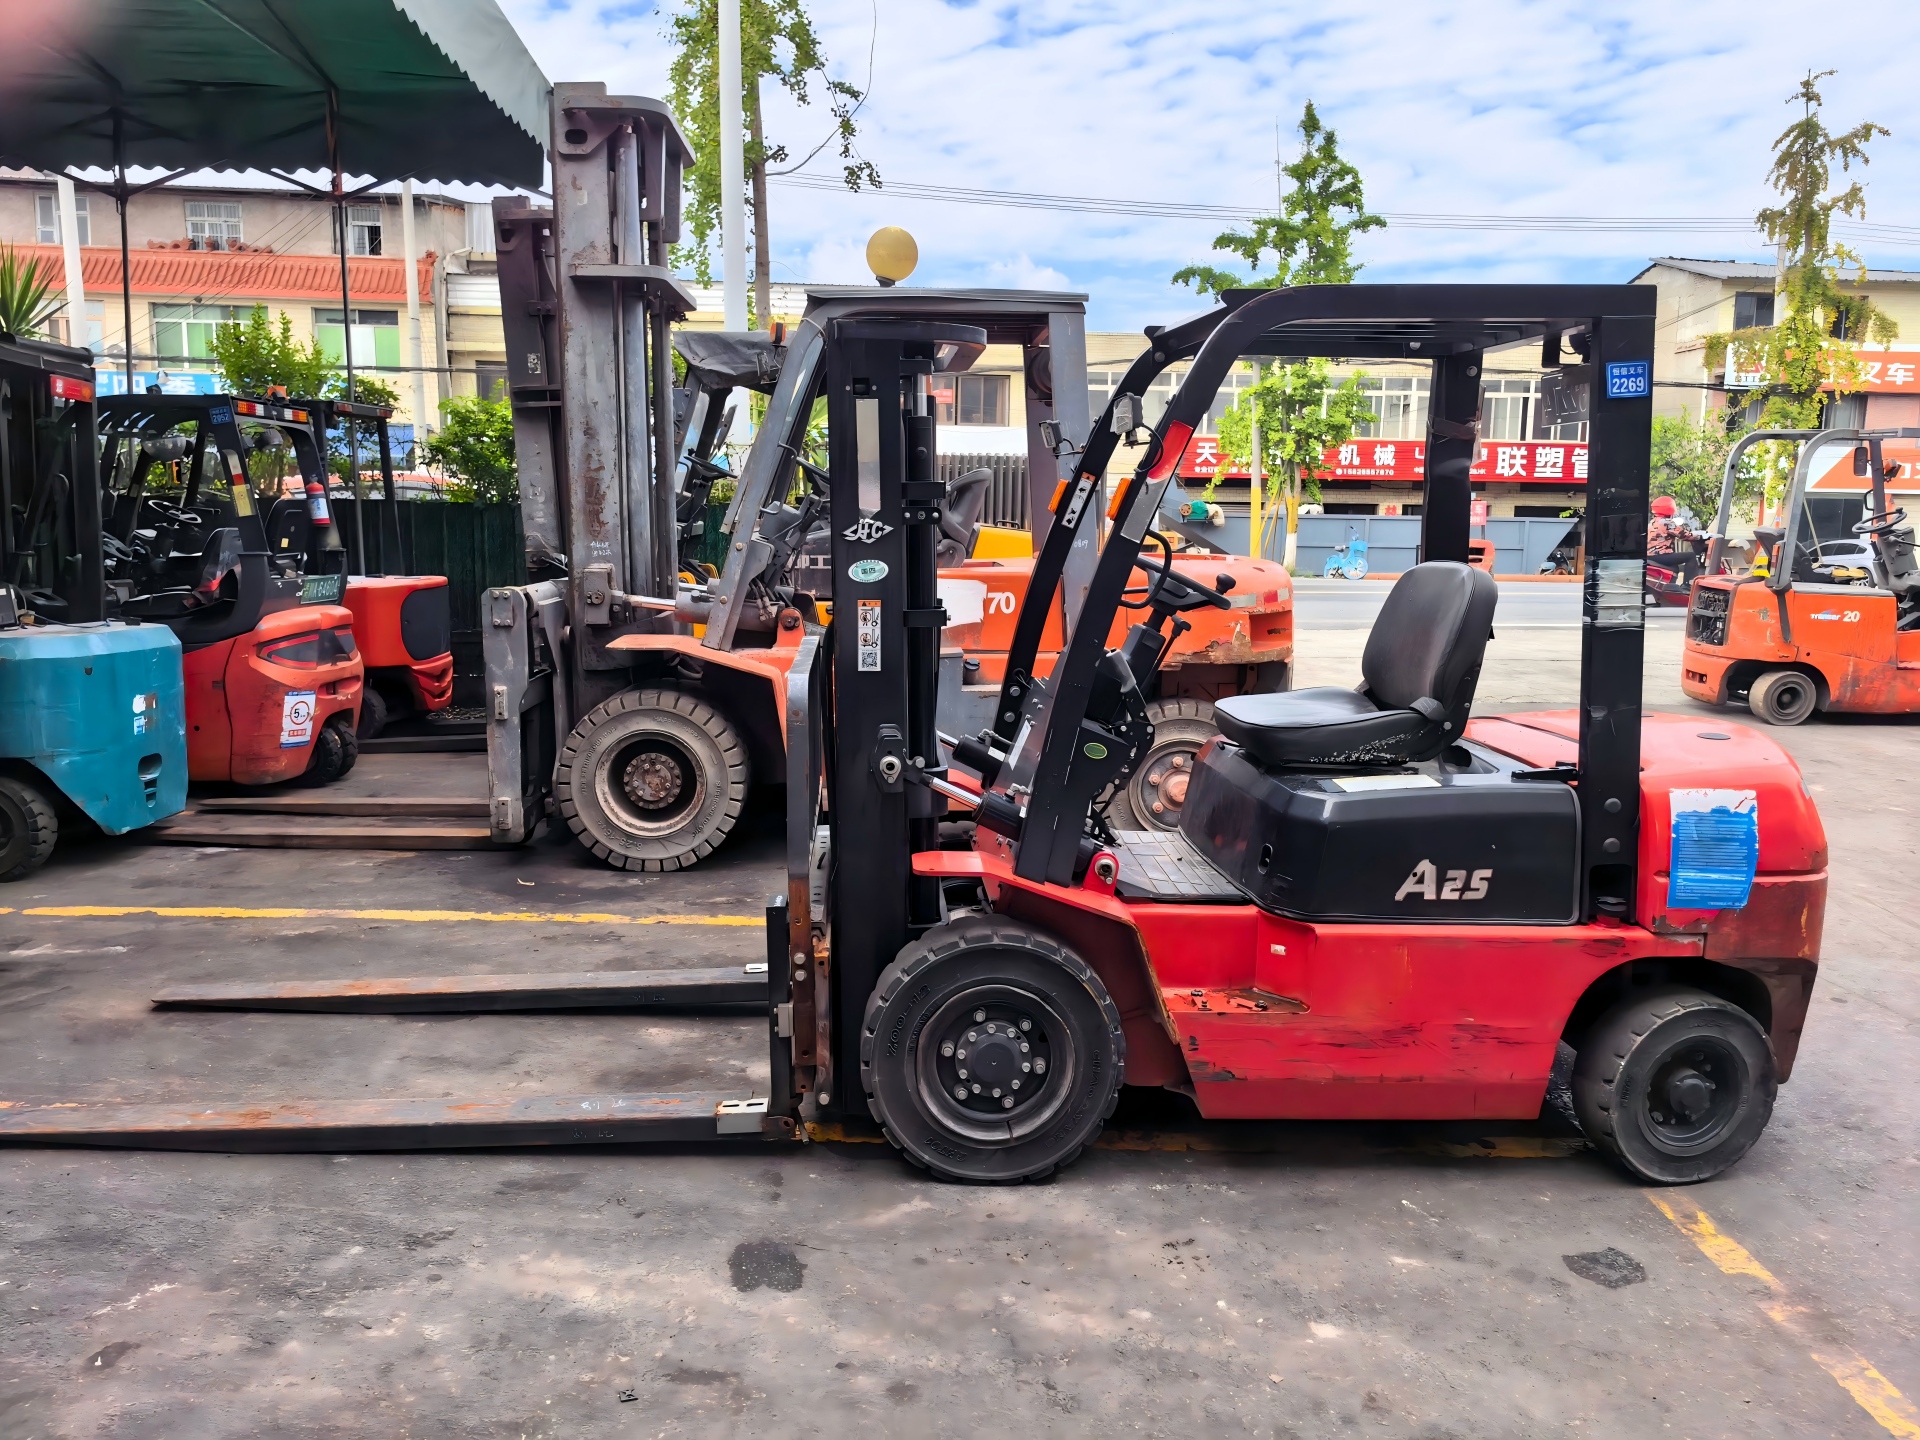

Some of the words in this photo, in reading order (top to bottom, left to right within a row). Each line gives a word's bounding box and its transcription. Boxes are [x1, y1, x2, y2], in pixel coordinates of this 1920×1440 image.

[1612, 366, 1644, 376] 恒信叉车
[1612, 376, 1645, 393] 2269
[987, 591, 1016, 614] 70
[1842, 610, 1861, 623] 20
[293, 708, 300, 718] 5
[1394, 858, 1493, 902] A25
